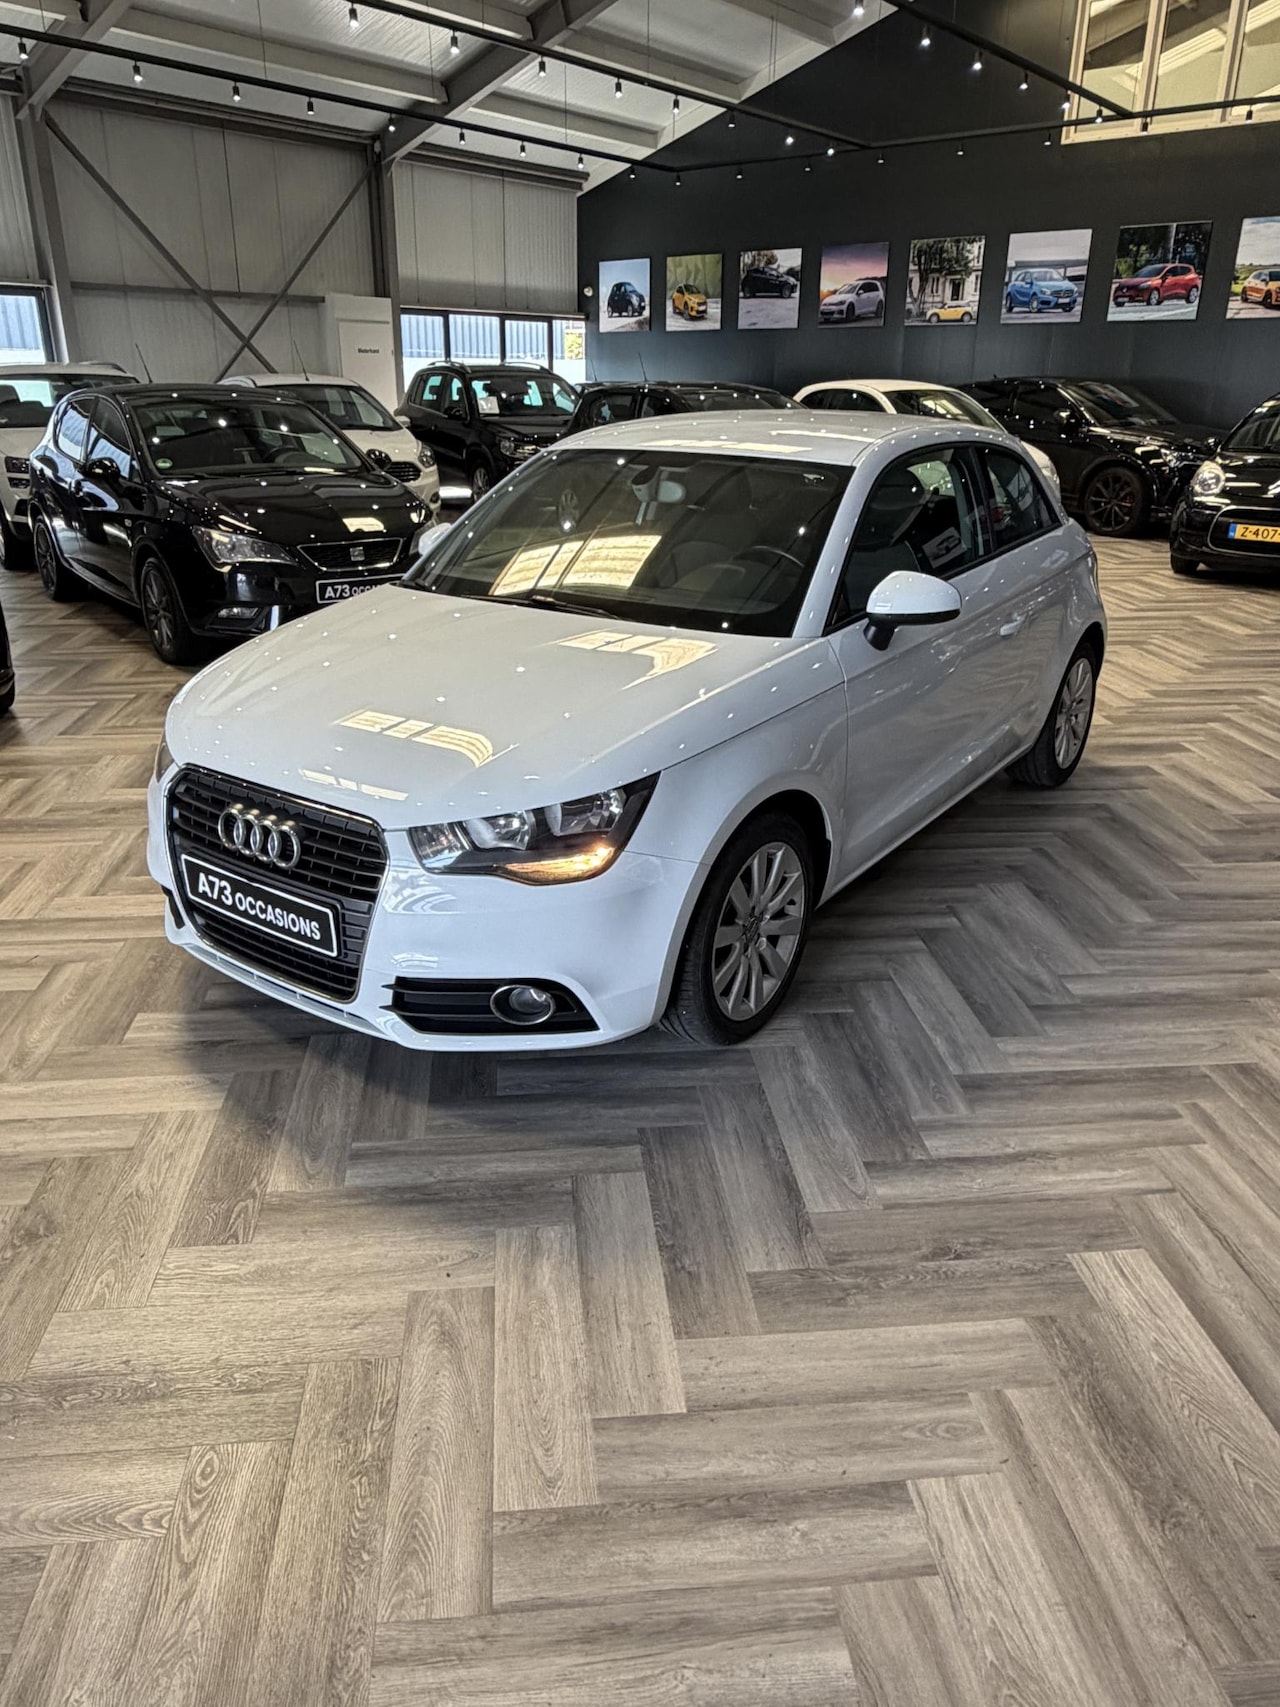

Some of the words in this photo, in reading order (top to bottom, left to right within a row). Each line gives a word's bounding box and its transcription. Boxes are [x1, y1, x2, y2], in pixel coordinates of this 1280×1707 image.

[324, 584, 350, 599] A73
[198, 872, 233, 906] A73
[234, 893, 321, 940] OCCASIONS
